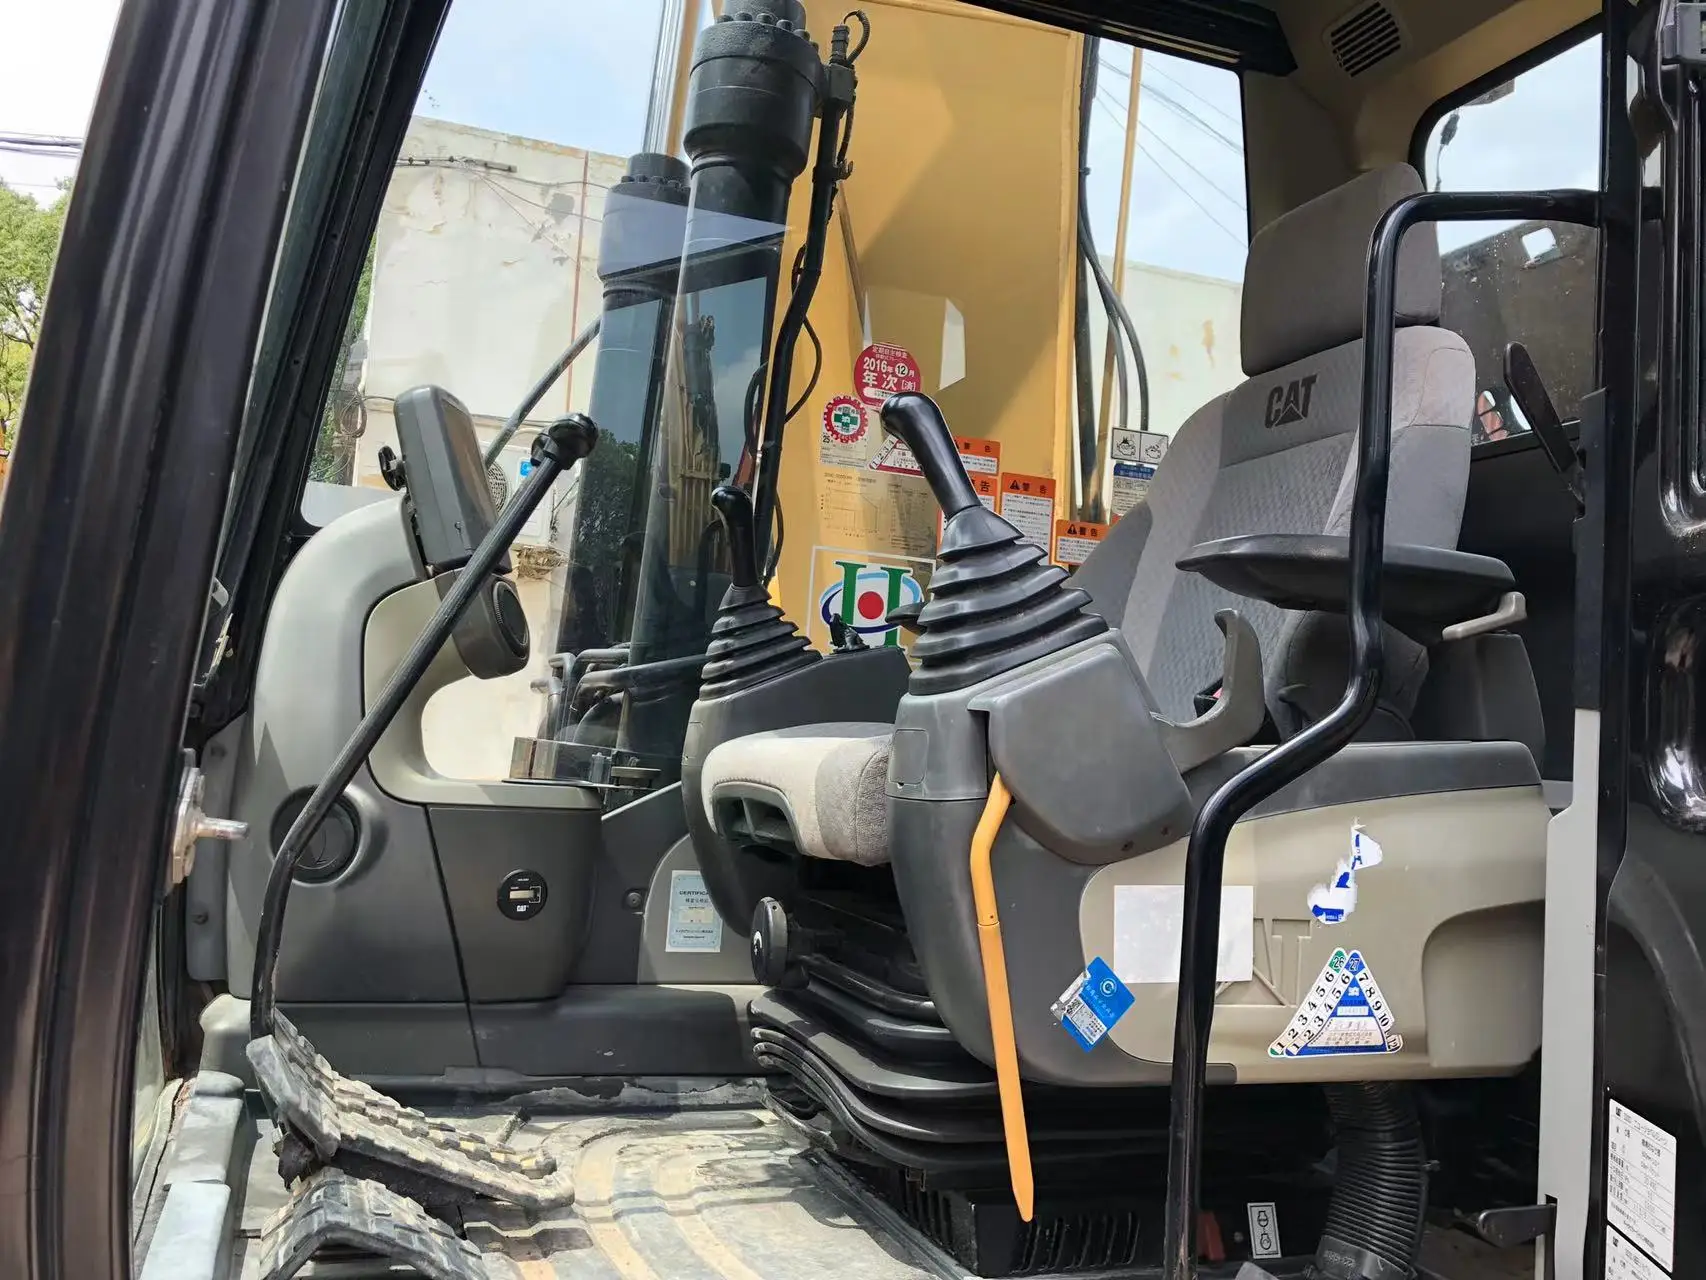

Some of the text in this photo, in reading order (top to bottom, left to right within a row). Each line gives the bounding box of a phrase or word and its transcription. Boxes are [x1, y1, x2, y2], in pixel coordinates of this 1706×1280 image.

[1264, 372, 1318, 429] CAT
[1333, 956, 1345, 969] 26
[1349, 958, 1360, 971] 27
[1325, 971, 1335, 983] 6
[1341, 973, 1351, 985] 6
[1359, 973, 1369, 982] 7
[1316, 986, 1326, 997] 5
[1331, 987, 1342, 999] 5
[1365, 987, 1376, 998] 8
[1308, 1001, 1318, 1011] 4
[1323, 1002, 1334, 1013] 4
[1372, 1000, 1382, 1011] 9
[1298, 1014, 1308, 1026] 3
[1314, 1015, 1324, 1027] 3
[1379, 1013, 1390, 1027] 10
[1288, 1028, 1299, 1039] 2
[1303, 1030, 1314, 1041] 2
[1276, 1041, 1285, 1052] 1
[1292, 1043, 1301, 1053] 1
